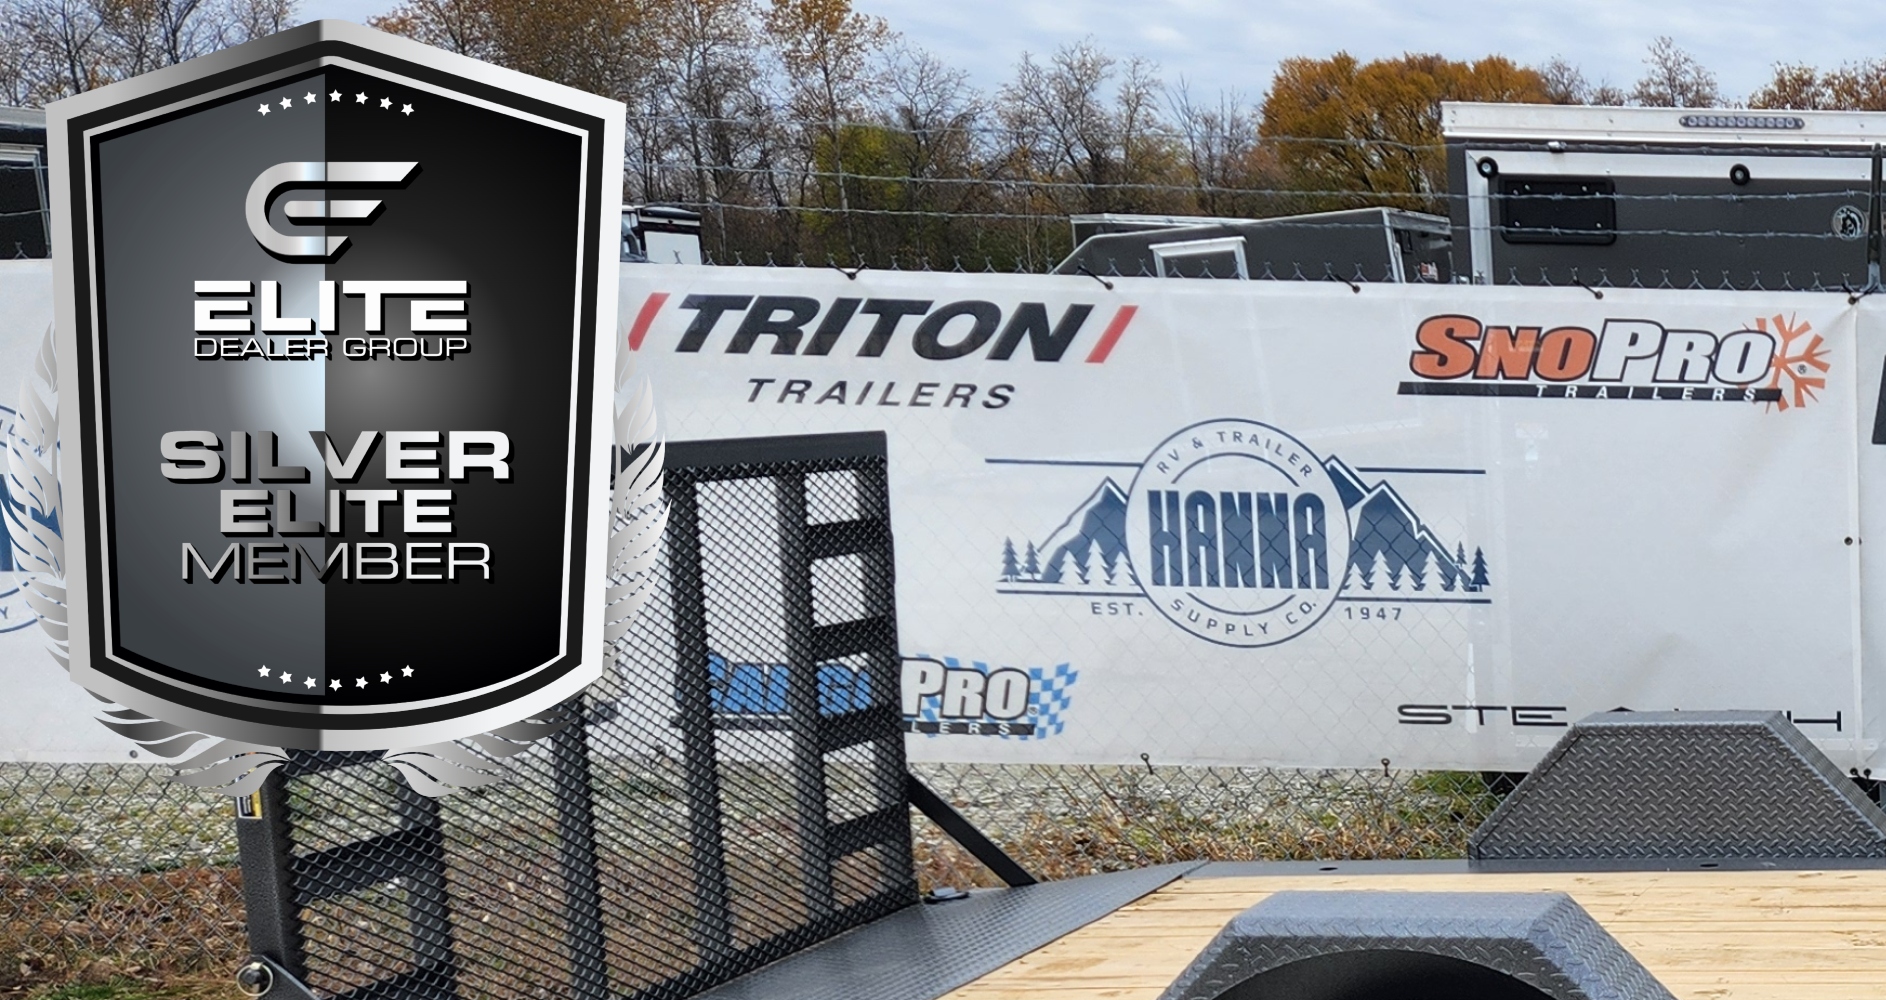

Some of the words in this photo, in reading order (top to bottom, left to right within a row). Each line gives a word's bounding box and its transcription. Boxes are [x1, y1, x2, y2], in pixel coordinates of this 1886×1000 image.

[675, 294, 1095, 363] TRITON
[747, 378, 1015, 409] TRAILERS
[1536, 385, 1756, 401] TRAILERS
[1156, 449, 1180, 474] RV
[1192, 436, 1204, 449] &
[1217, 431, 1313, 477] TRAILER
[1147, 490, 1329, 589] HANNA
[1091, 601, 1143, 617] EST.
[1171, 598, 1269, 636] SUPPLY
[1285, 601, 1317, 625] CO.
[1344, 607, 1402, 620] 1947
[910, 722, 1011, 736] LERS
[1398, 705, 1841, 732] STEH
